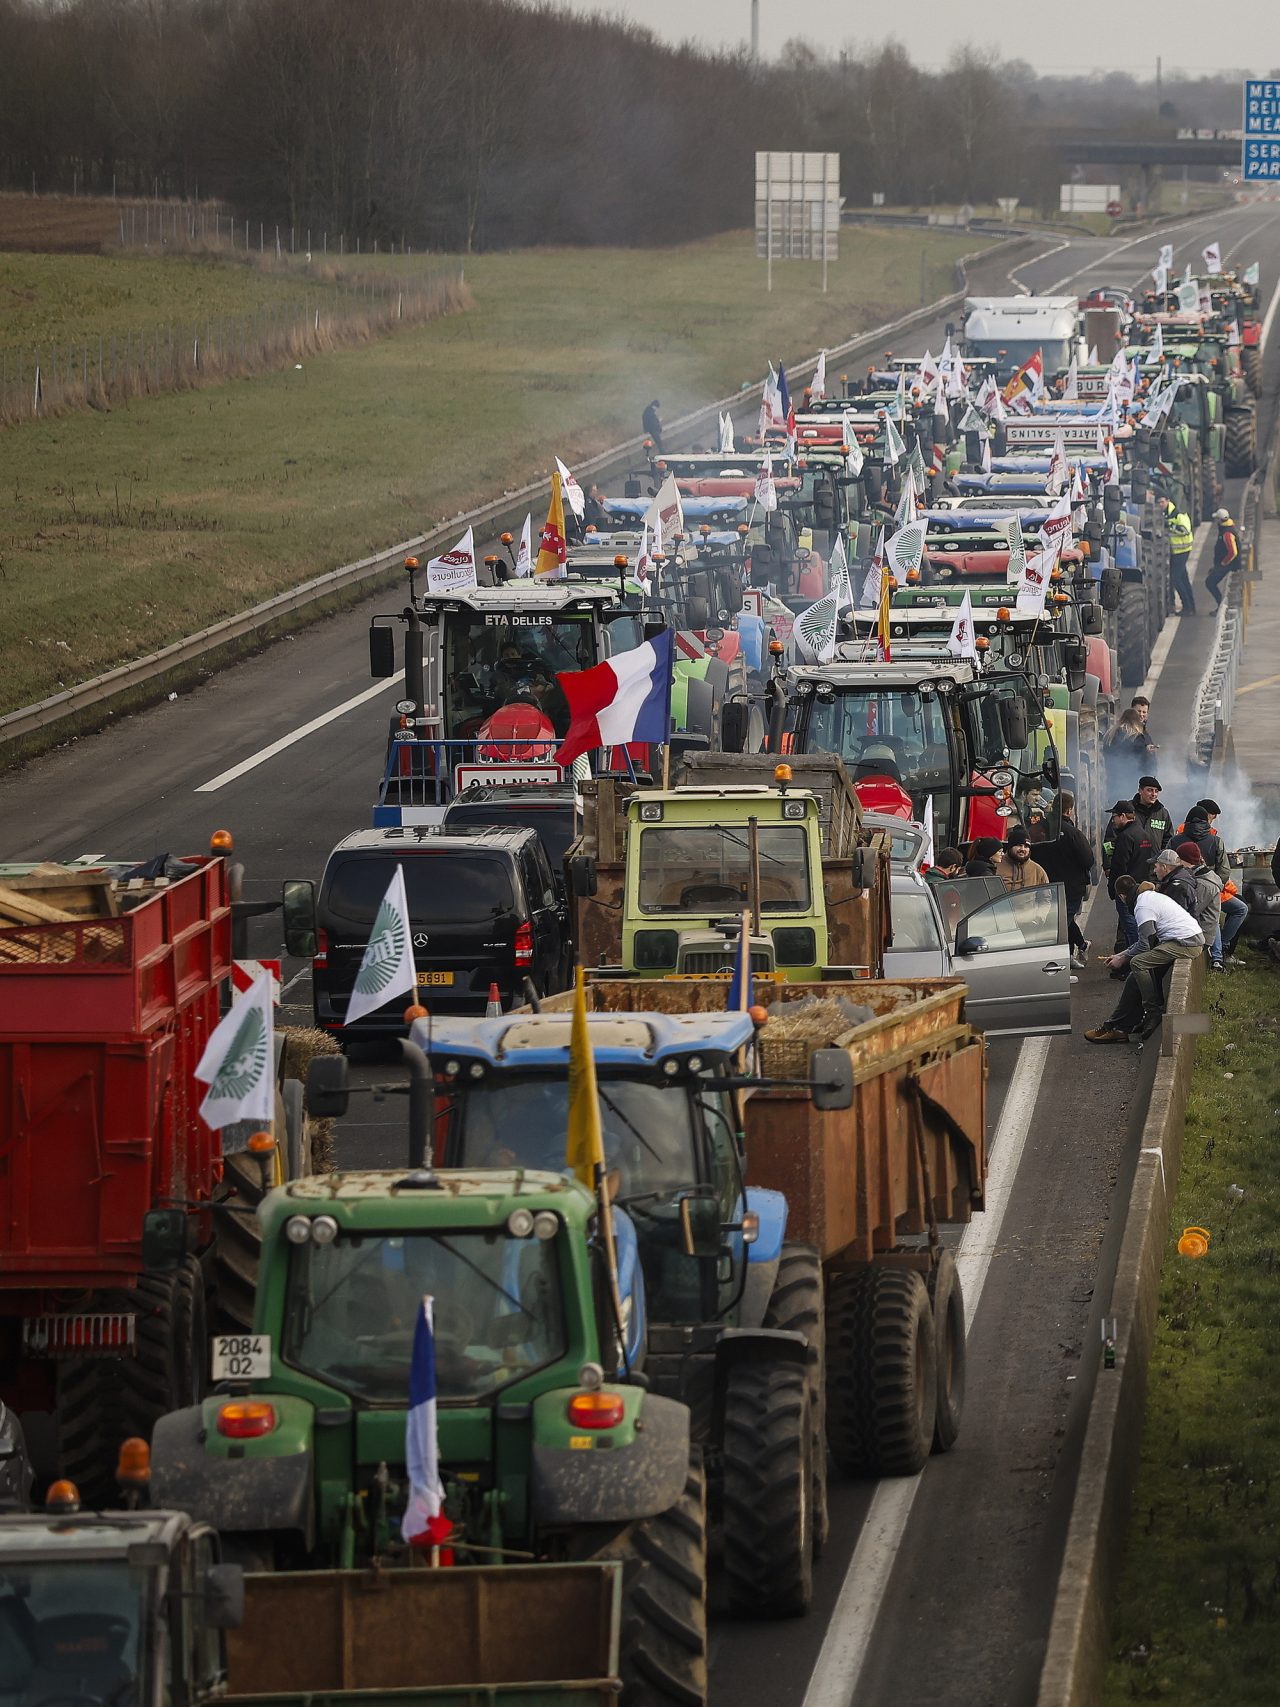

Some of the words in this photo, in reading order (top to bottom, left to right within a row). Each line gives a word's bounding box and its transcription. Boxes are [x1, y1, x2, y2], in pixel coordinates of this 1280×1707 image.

[485, 615, 509, 626] ETA
[512, 617, 553, 626] DELLES
[419, 973, 445, 983] 5691
[219, 1338, 263, 1356] 2084
[230, 1357, 252, 1375] 02
